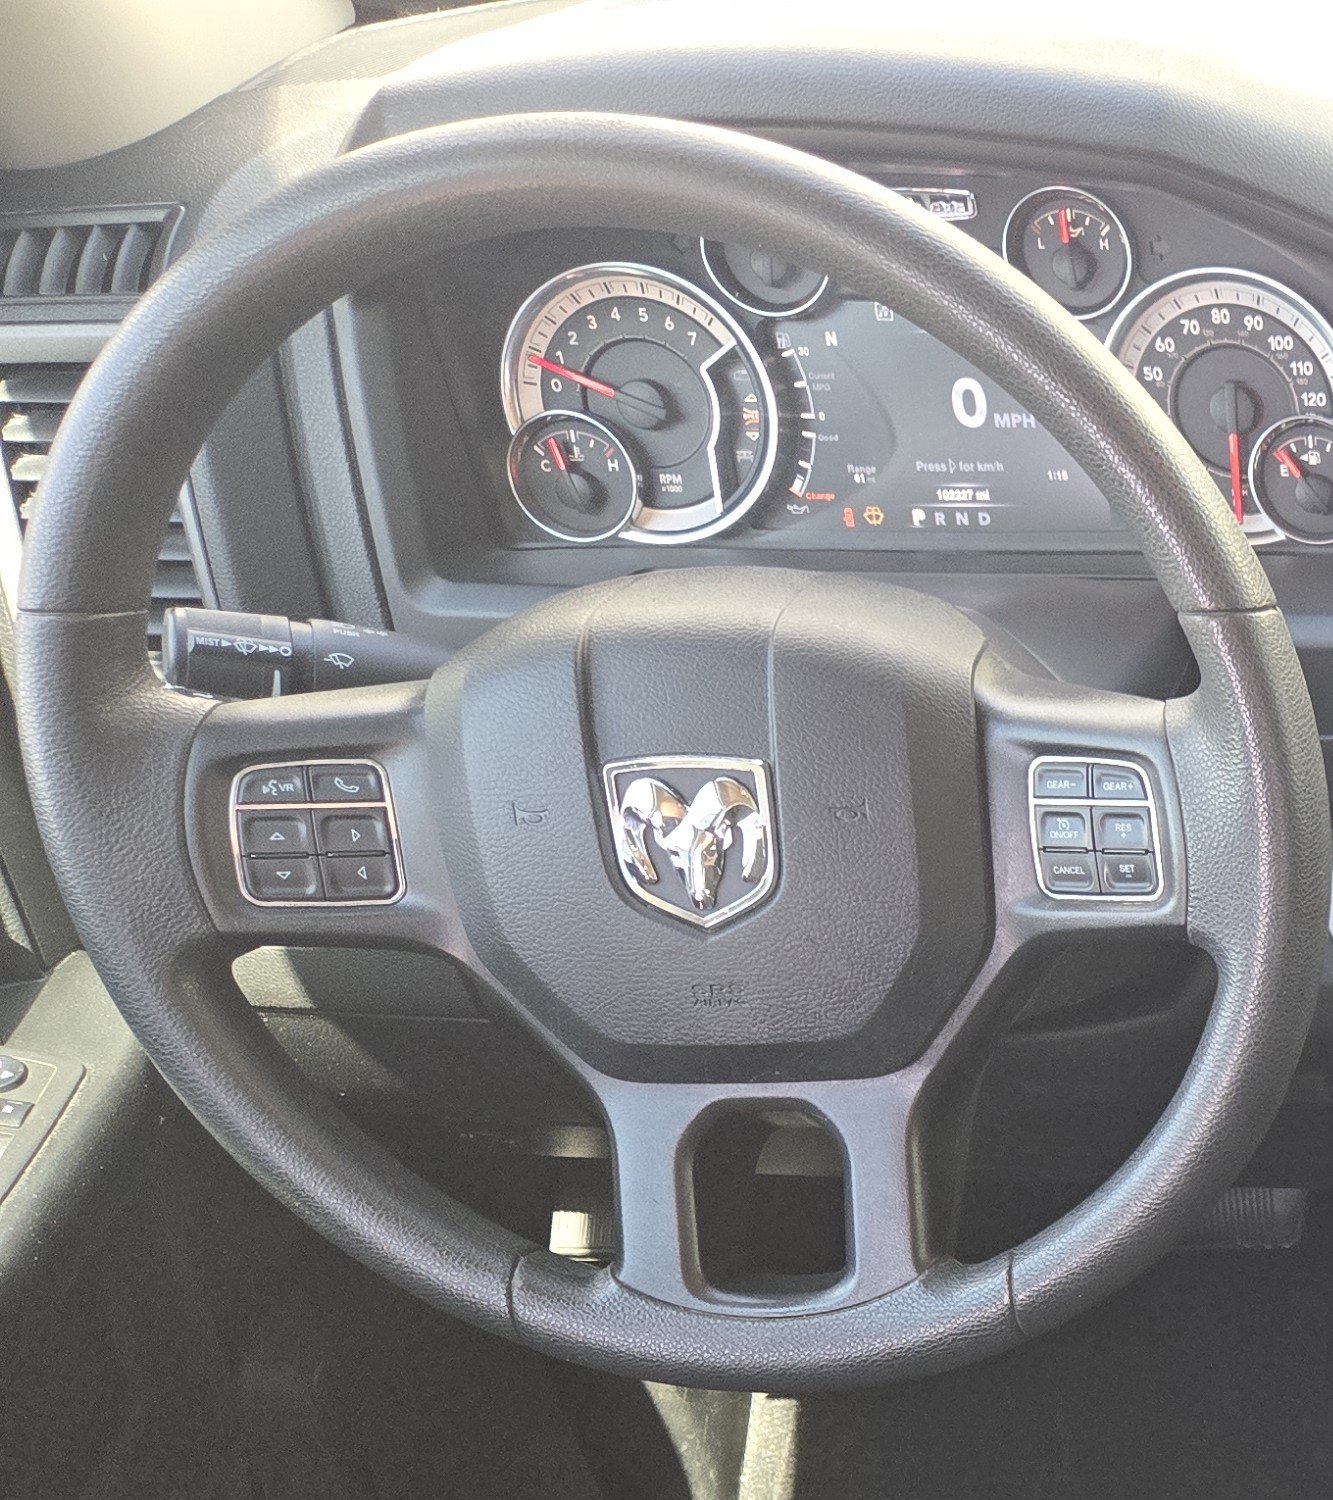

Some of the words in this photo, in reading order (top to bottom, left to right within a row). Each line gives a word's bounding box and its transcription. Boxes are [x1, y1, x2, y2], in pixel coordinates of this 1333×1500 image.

[1038, 237, 1045, 250] L
[1099, 238, 1110, 250] H
[610, 307, 621, 322] 4
[638, 308, 649, 322] 5
[1211, 307, 1231, 324] 80
[586, 315, 598, 330] 3
[664, 316, 675, 331] 6
[1180, 319, 1201, 335] 70
[1243, 315, 1264, 331] 90
[567, 331, 579, 346] 2
[687, 331, 697, 346] 7
[825, 330, 838, 347] N
[1155, 336, 1176, 353] 60
[1267, 335, 1294, 351] 100
[555, 350, 565, 365] 1
[798, 347, 810, 357] 30
[1142, 366, 1164, 382] 50
[1289, 361, 1314, 376] 110
[550, 378, 563, 393] 0
[951, 377, 988, 429] 0
[993, 412, 1037, 429] MPH
[1300, 392, 1327, 407] 120
[818, 411, 826, 421] 0
[540, 459, 552, 472] C
[607, 459, 620, 472] H
[915, 460, 948, 472] Press
[958, 460, 974, 472] for
[977, 460, 1005, 473] km/h
[1280, 464, 1289, 477] E
[659, 473, 683, 485] RPM
[911, 508, 926, 526] P
[934, 512, 947, 526] R
[955, 511, 970, 526] N
[978, 511, 991, 526] D
[195, 636, 220, 646] MIST
[278, 783, 294, 792] VR
[1049, 831, 1079, 839] ON/OFF
[1115, 823, 1132, 832] RES
[1053, 866, 1086, 875] CANCEL
[1119, 864, 1135, 873] SET
